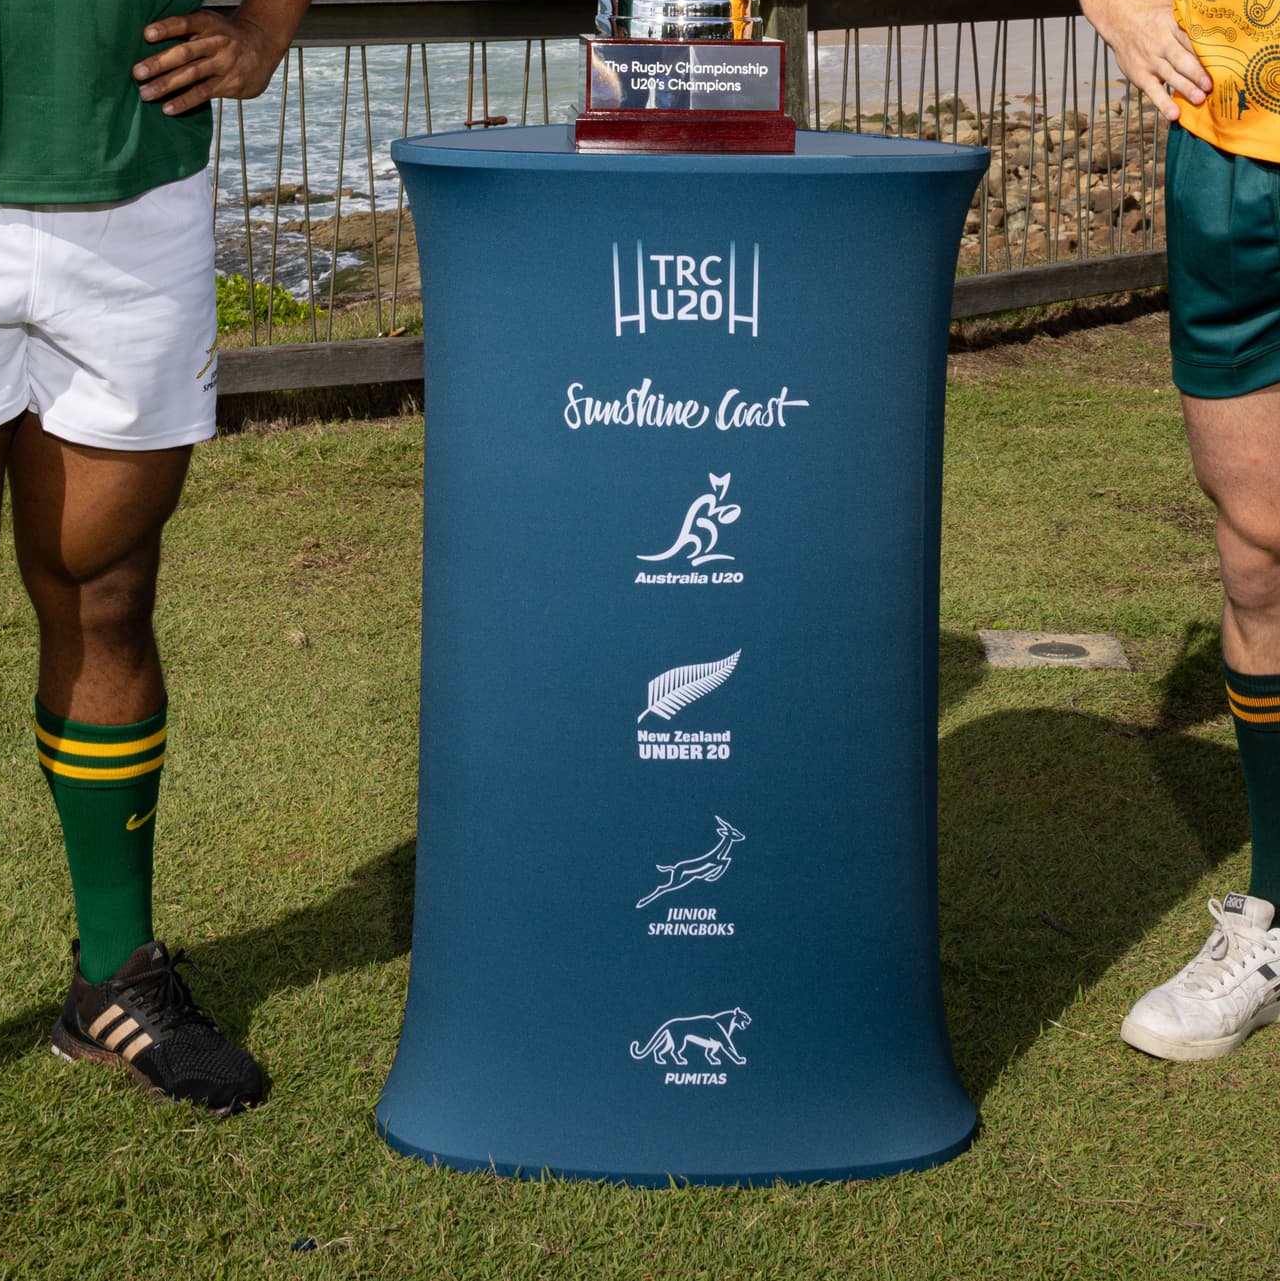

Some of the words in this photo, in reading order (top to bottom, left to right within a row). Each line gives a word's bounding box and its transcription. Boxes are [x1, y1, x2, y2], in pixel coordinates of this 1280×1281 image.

[604, 61, 629, 73] The
[631, 61, 672, 76] Rugby
[675, 61, 769, 77] Championship
[631, 78, 665, 90] U20's
[668, 78, 742, 93] Champions
[650, 255, 722, 286] TRC
[650, 289, 722, 321] U20
[564, 378, 710, 429] Sunshine
[715, 386, 810, 431] Coast
[634, 572, 708, 585] Australia
[711, 572, 744, 584] U20
[637, 730, 670, 742] New
[674, 730, 731, 742] Zealand
[638, 744, 703, 760] UNDER
[706, 744, 730, 760] 20
[666, 907, 717, 921] JUNIOR
[647, 923, 735, 936] SPRINGBOKS
[664, 1073, 728, 1085] PUMITAS
